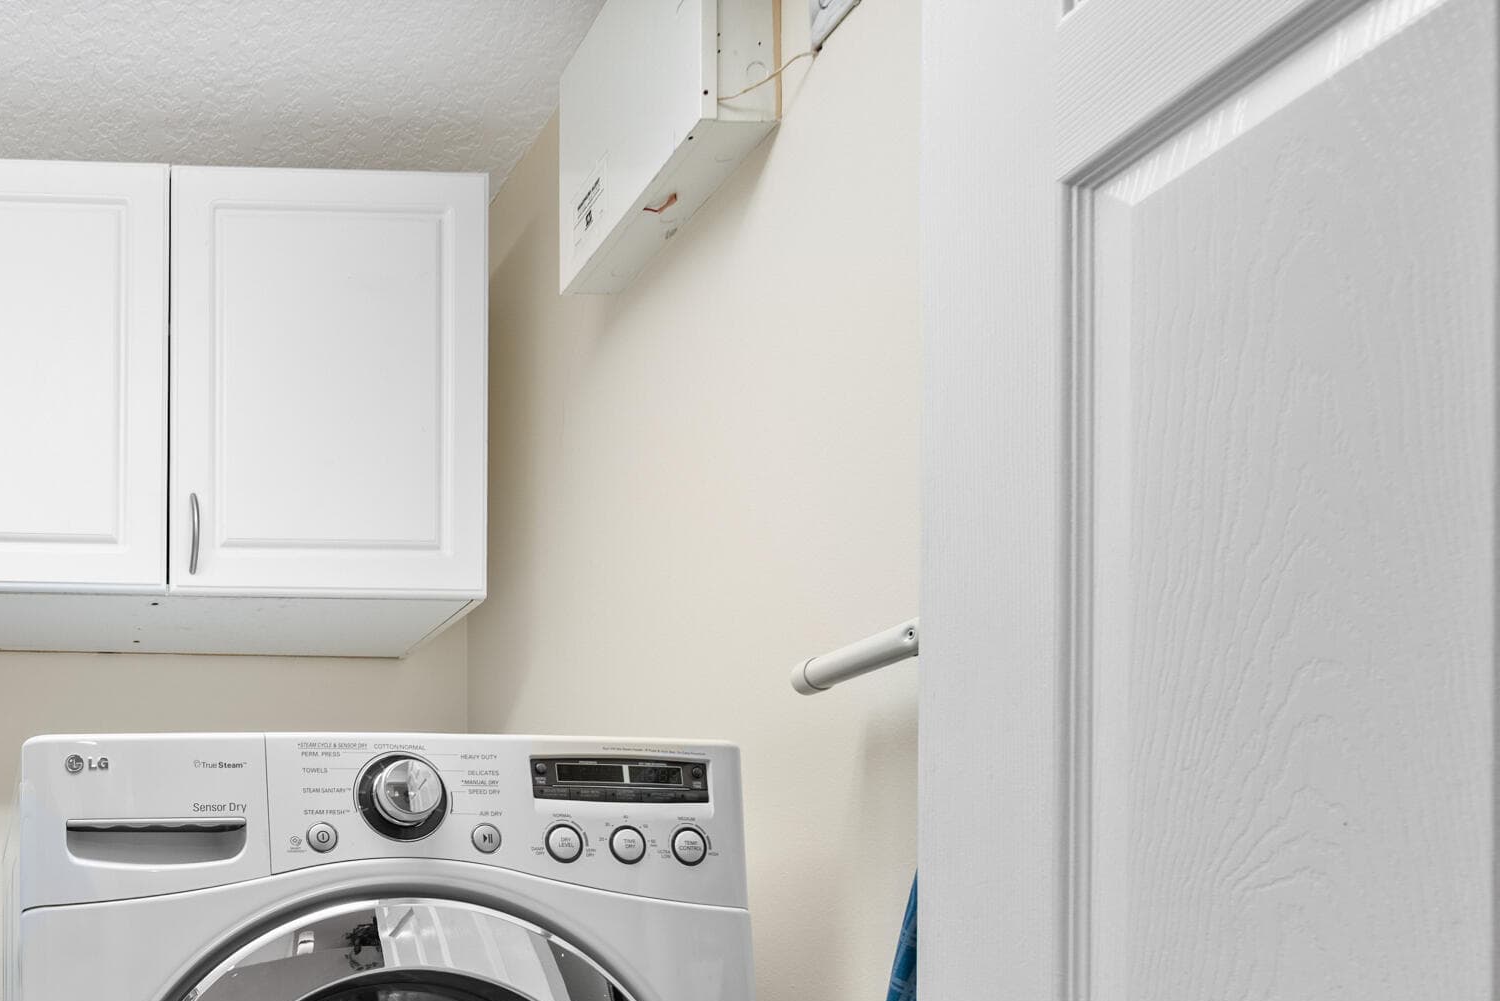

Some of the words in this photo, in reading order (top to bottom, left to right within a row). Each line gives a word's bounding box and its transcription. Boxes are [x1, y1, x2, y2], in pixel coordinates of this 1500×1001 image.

[88, 757, 109, 771] LG
[192, 802, 226, 812] Sensor
[229, 802, 246, 813] Dry
